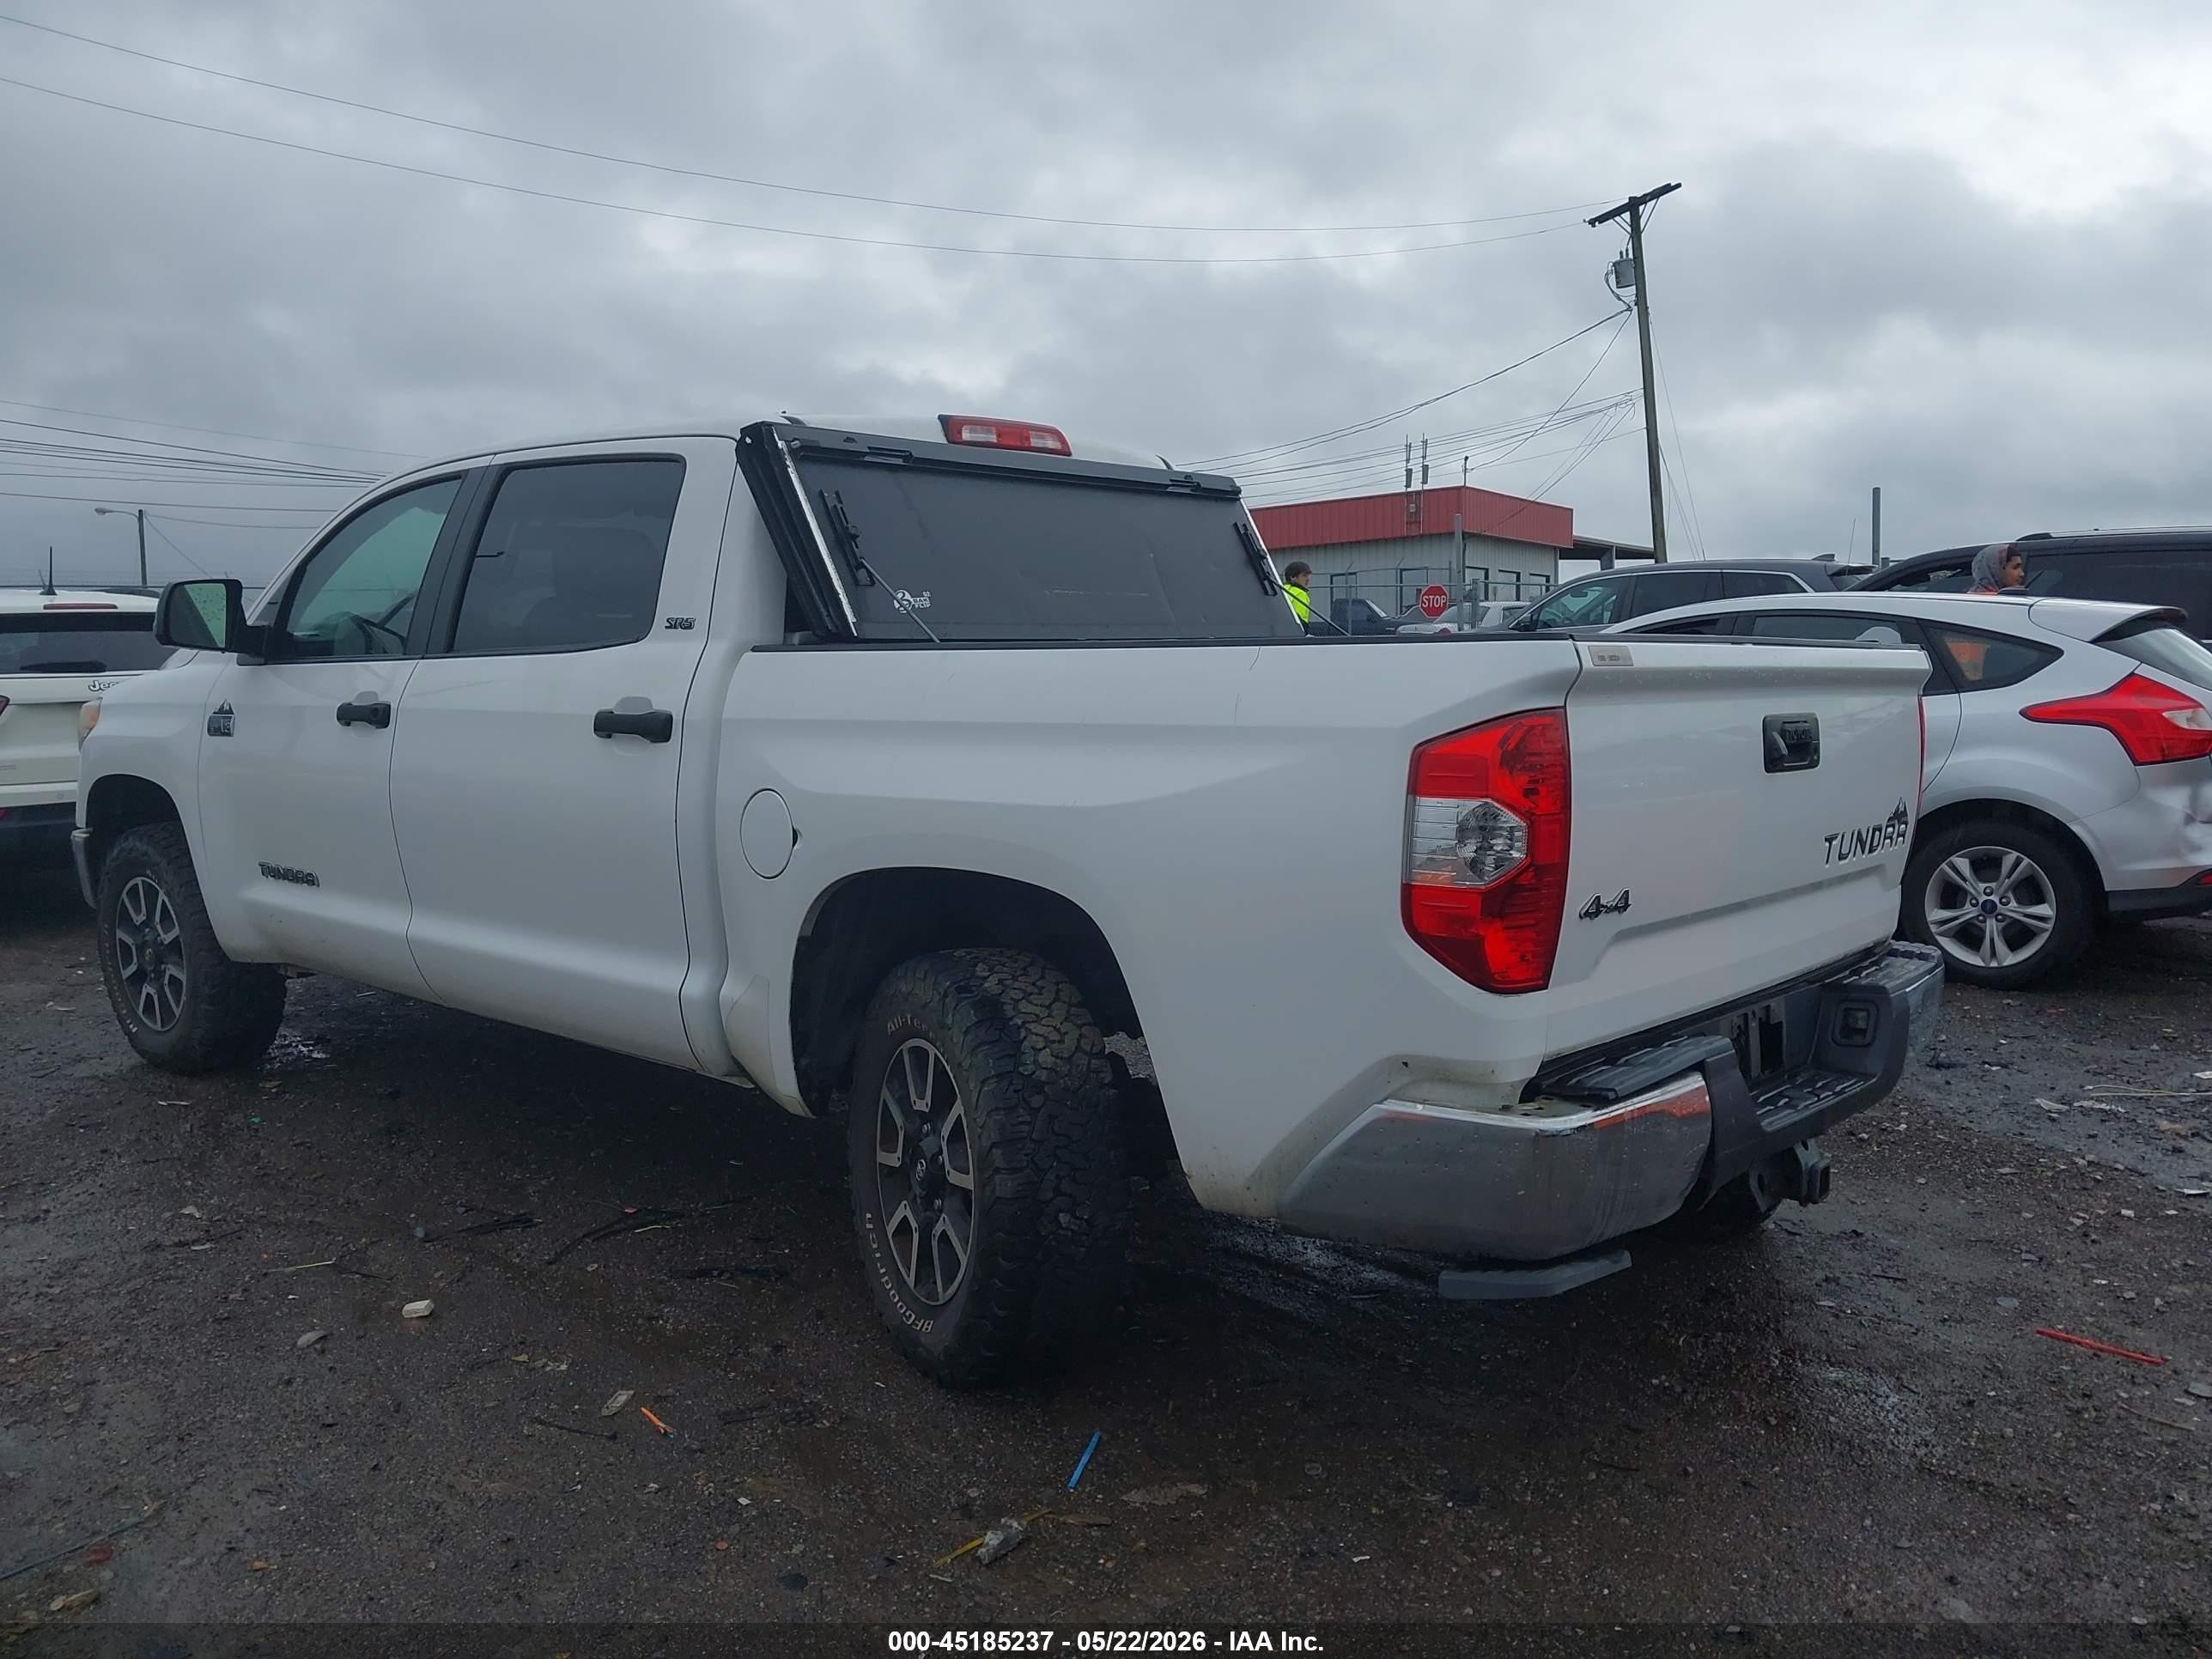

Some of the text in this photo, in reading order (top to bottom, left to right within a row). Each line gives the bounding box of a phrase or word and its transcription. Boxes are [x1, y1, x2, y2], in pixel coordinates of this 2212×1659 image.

[1422, 595, 1447, 608] STOP
[665, 617, 696, 629] SR5
[88, 679, 119, 692] Je
[1824, 817, 1909, 866] TUNDRA
[258, 861, 320, 887] TUNDRA
[1579, 888, 1632, 920] 4x4
[866, 1212, 934, 1333] BFGoodrich
